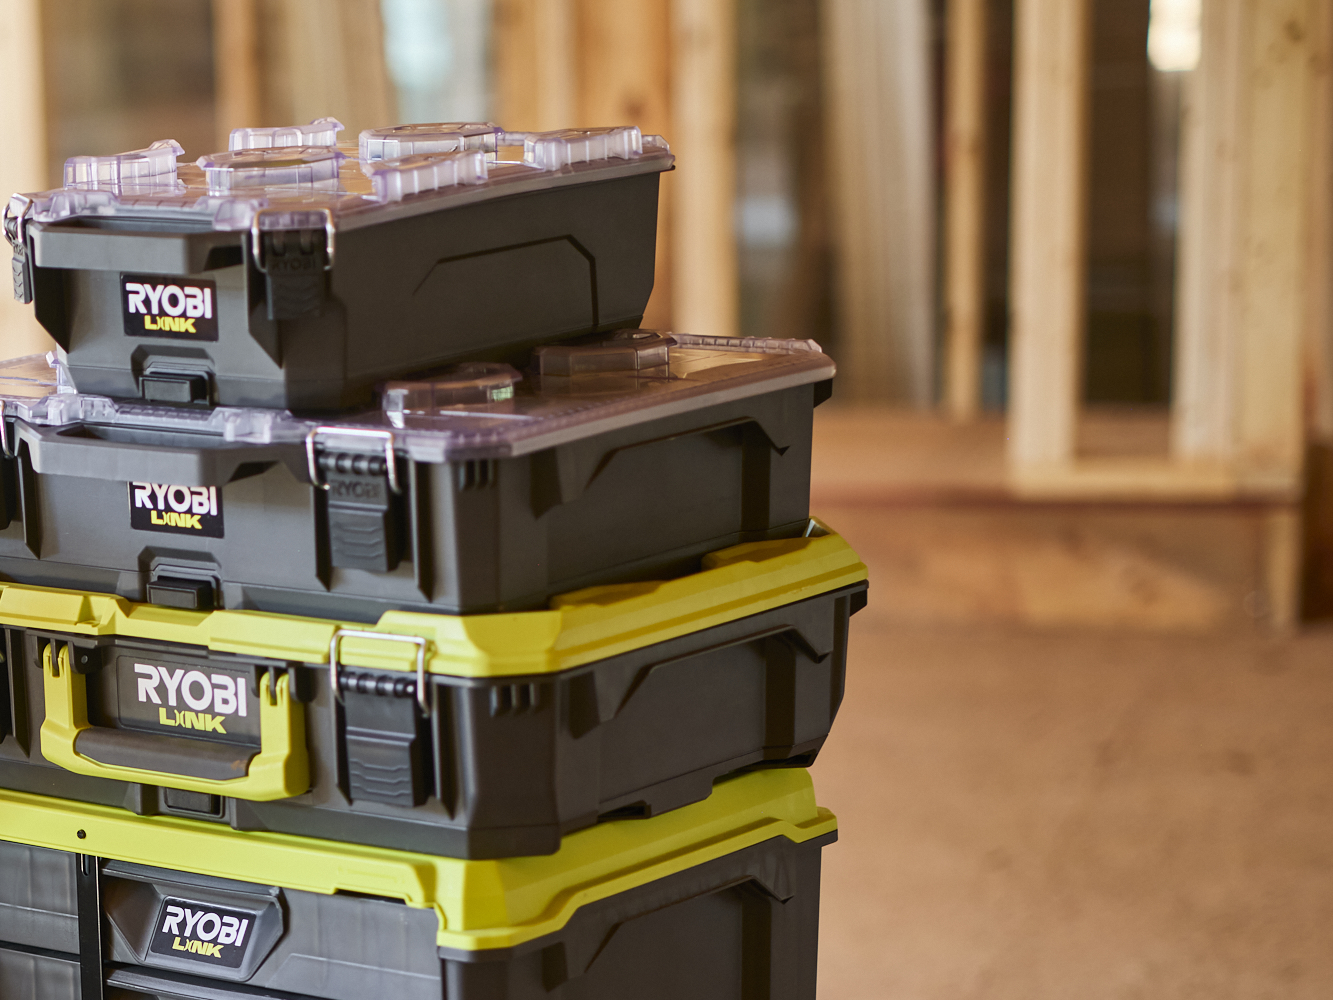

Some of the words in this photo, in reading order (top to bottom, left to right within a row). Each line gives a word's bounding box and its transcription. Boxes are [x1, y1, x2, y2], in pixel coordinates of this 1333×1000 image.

[126, 283, 212, 319] RYOBI
[133, 482, 217, 516] RYOBI
[134, 663, 247, 717] RYOBI
[162, 905, 249, 947] RYOBI
